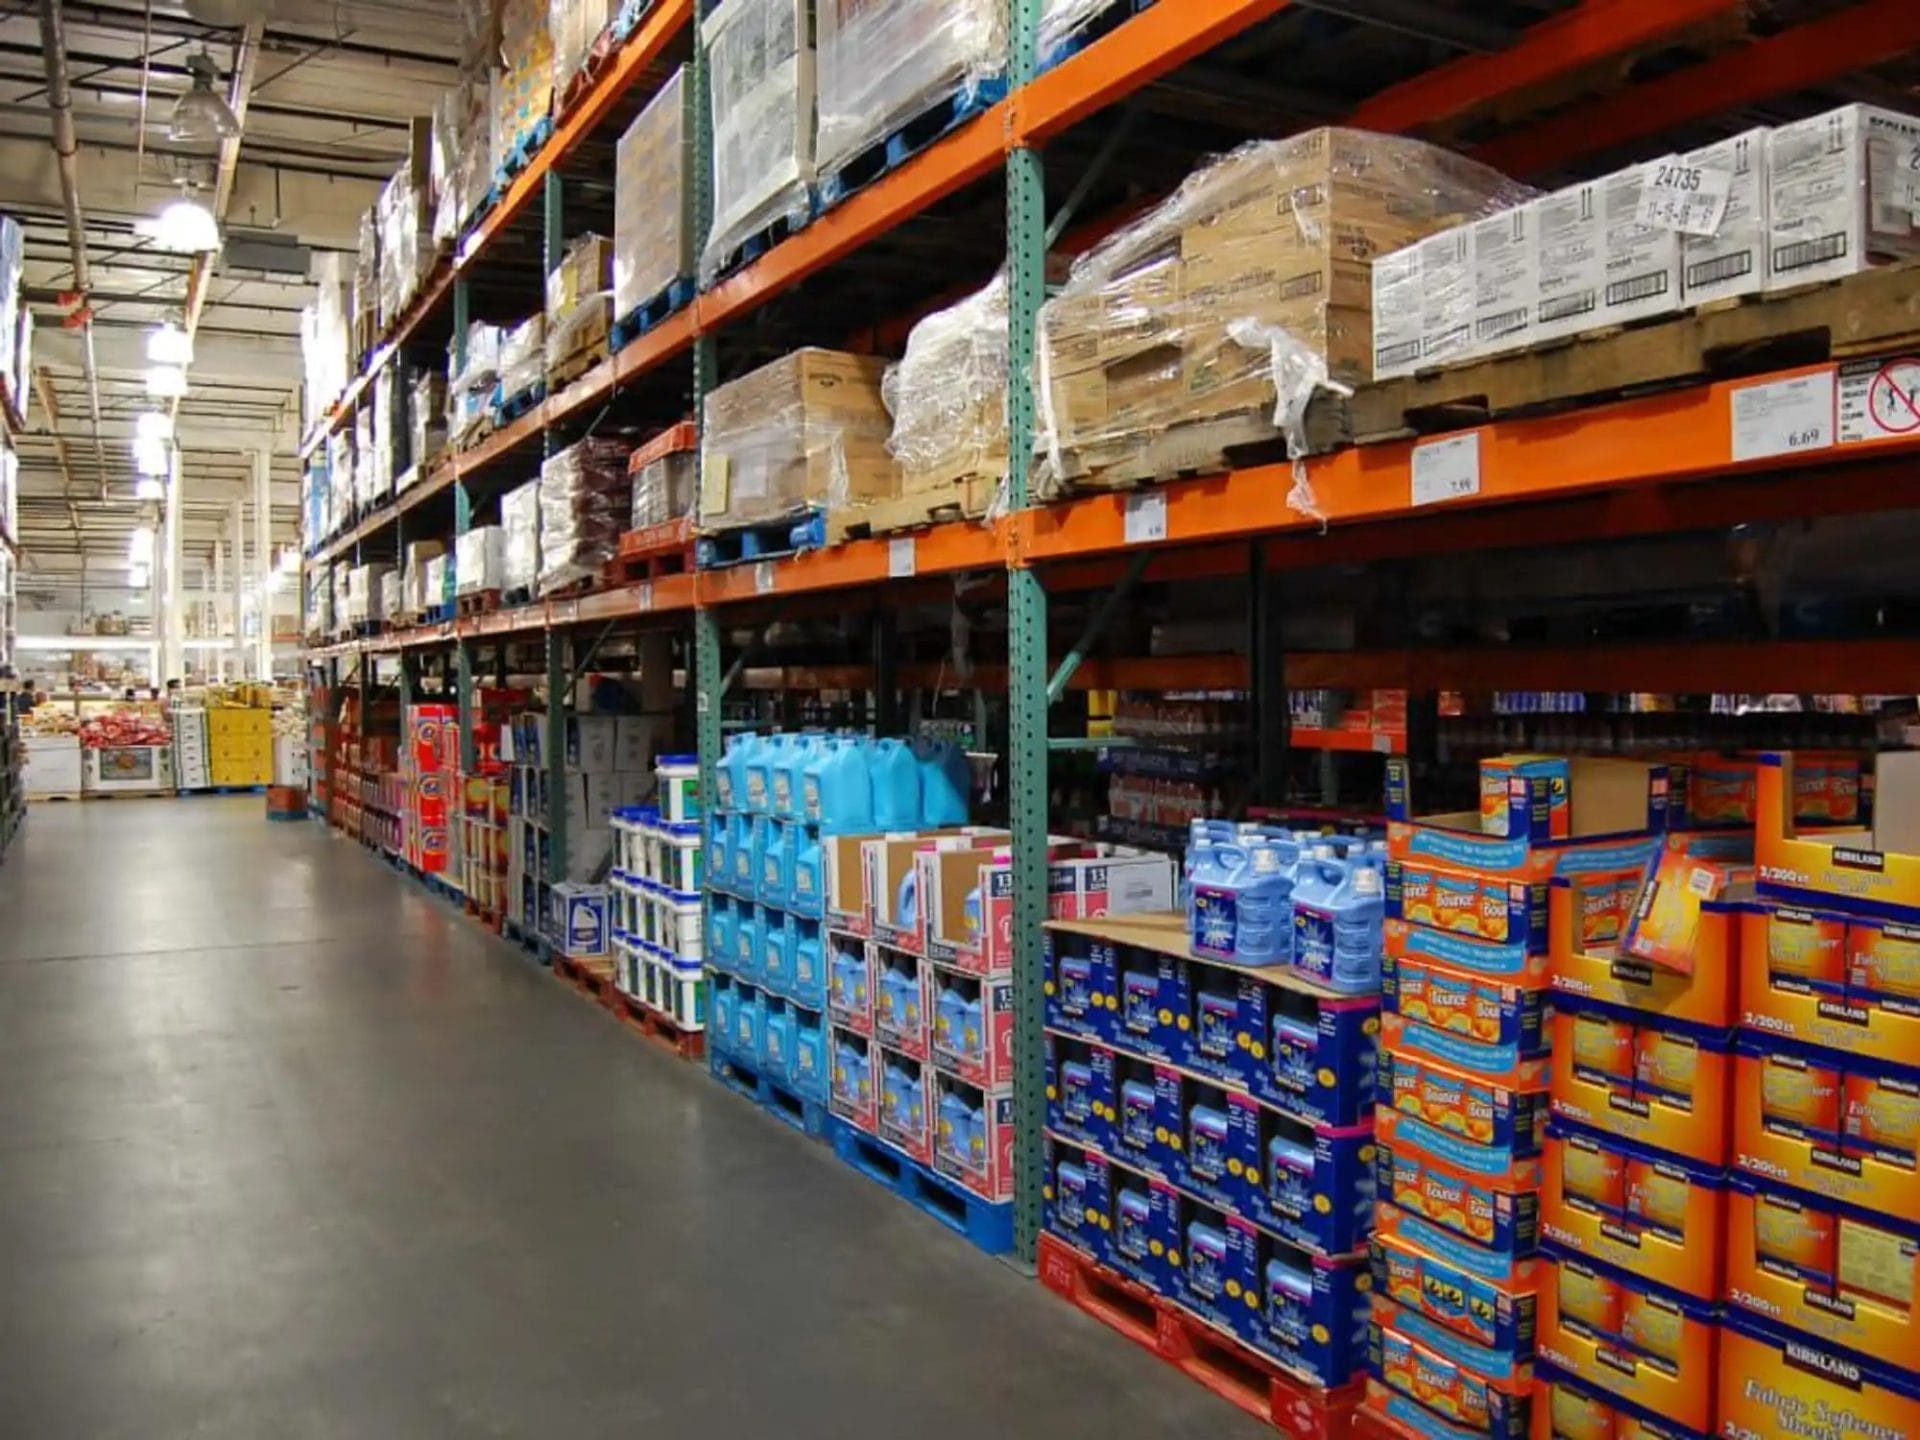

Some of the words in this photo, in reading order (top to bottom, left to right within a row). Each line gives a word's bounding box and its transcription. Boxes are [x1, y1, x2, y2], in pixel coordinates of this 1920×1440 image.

[1654, 165, 1703, 191] 24735
[1785, 1341, 1861, 1382] KIRKLAND
[1744, 1379, 1809, 1414] Fabric
[1815, 1400, 1908, 1440] Softener
